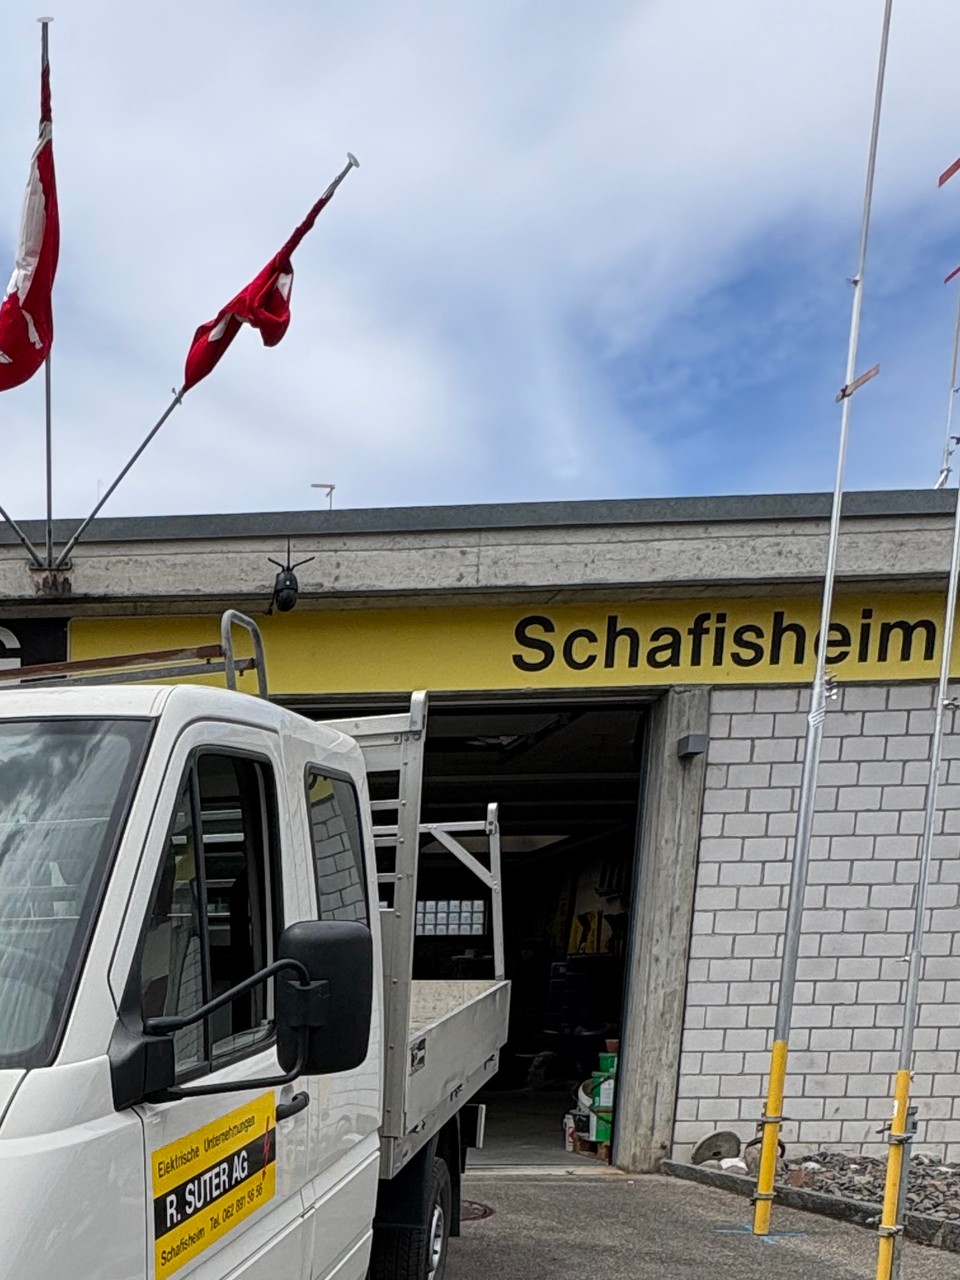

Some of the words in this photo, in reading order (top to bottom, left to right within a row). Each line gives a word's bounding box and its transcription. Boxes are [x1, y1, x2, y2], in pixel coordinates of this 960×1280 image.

[512, 608, 937, 672] Schafisheim
[157, 1146, 200, 1178] Elektrische
[203, 1115, 256, 1153] Unternehmungen
[166, 1193, 181, 1228] R.
[185, 1162, 229, 1214] SUTER
[232, 1149, 248, 1186] AG
[161, 1226, 206, 1267] Schafisheim
[222, 1202, 234, 1223] 062
